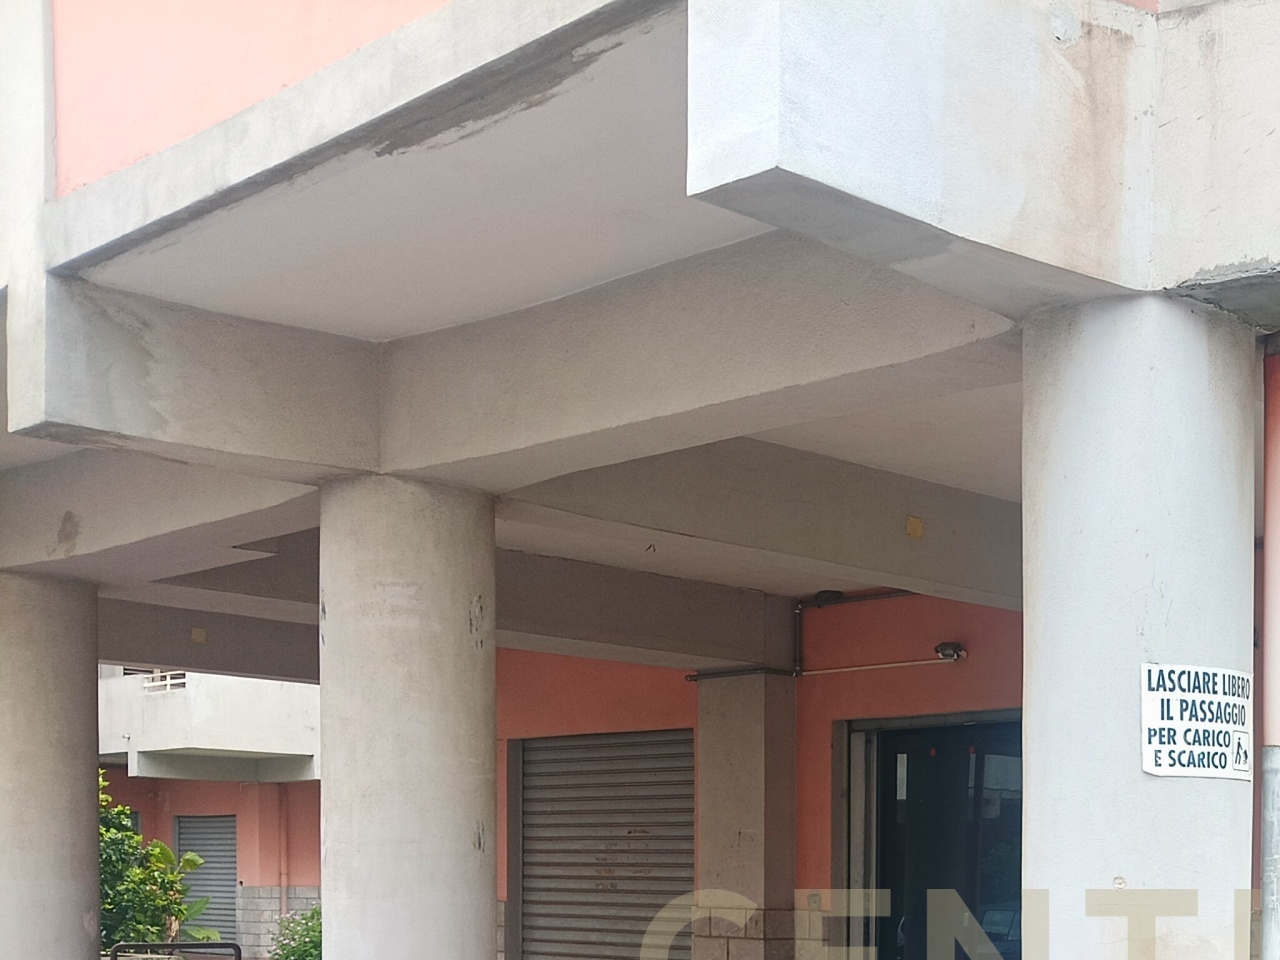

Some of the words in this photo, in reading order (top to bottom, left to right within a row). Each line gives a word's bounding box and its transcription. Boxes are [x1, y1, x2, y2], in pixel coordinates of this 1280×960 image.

[1147, 669, 1218, 695] LASCIARE
[1222, 673, 1250, 700] LIBERO
[1160, 698, 1174, 721] IL
[1180, 699, 1246, 726] PASSAGGIO
[1147, 727, 1177, 745] PER
[1183, 728, 1231, 748] CARICO
[1154, 750, 1162, 767] E
[1168, 750, 1227, 769] SCARICO
